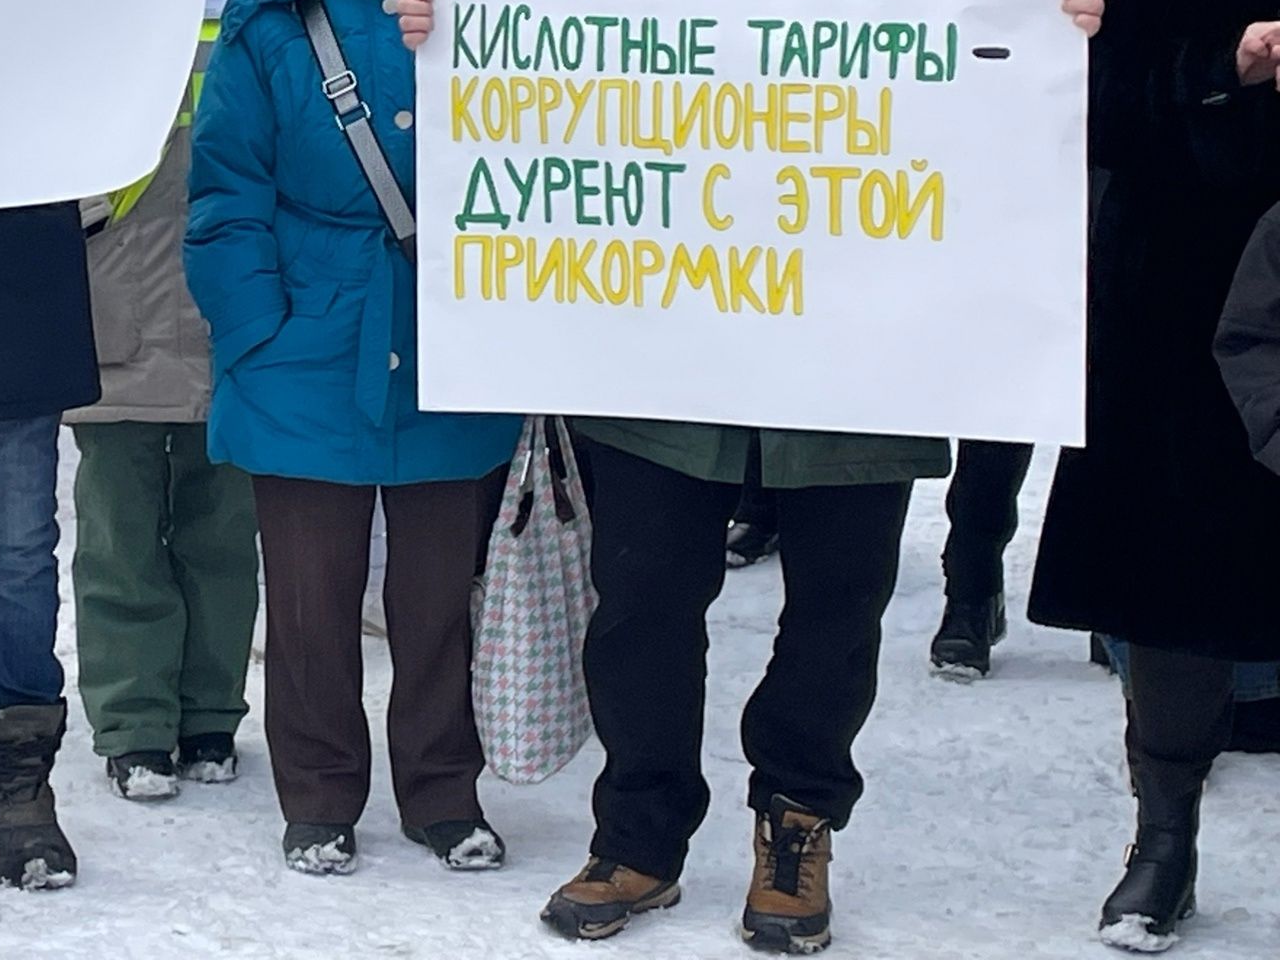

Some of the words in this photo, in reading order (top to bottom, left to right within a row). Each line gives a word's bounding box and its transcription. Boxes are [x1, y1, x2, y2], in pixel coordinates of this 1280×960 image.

[451, 2, 719, 77] КИСЛОТНЫЕ
[747, 18, 959, 82] ТАРИФЫ
[451, 76, 892, 156] КОРРУПЦИОНЕРЫ
[454, 156, 687, 230] ДУРЕЮТ
[702, 162, 735, 231] С
[775, 159, 946, 242] ЭТОЙ
[453, 235, 805, 316] ПРИКОРМКИ
